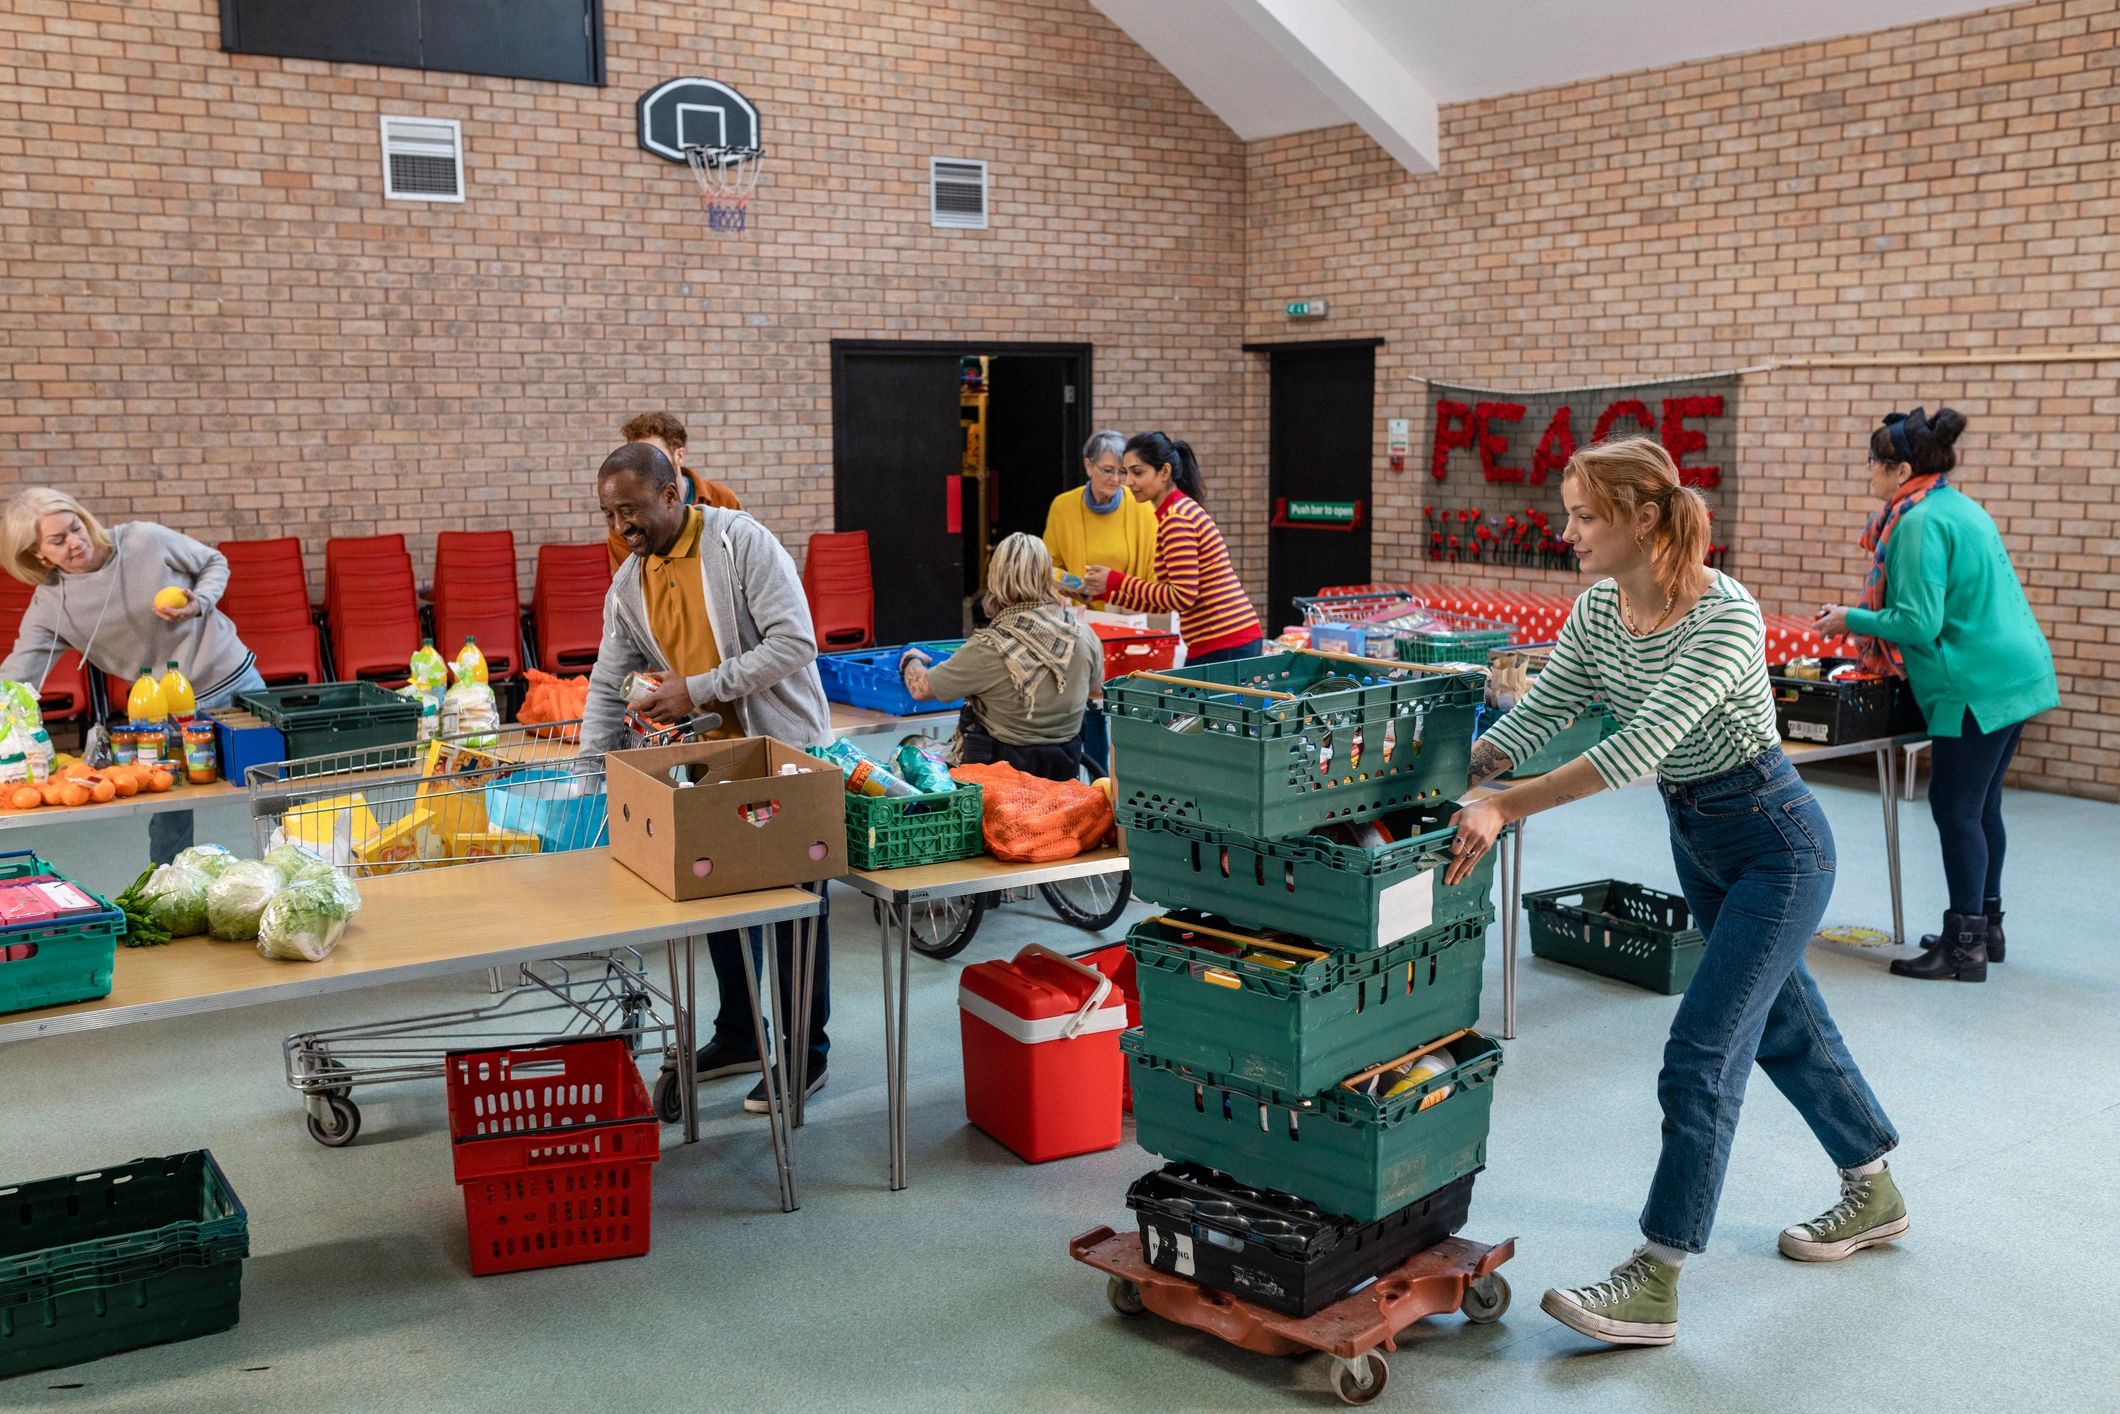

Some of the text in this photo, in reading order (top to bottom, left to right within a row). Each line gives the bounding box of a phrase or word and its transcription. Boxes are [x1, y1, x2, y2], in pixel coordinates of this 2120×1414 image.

[1431, 396, 1723, 488] PEACE
[1291, 504, 1354, 518] Push bar to open
